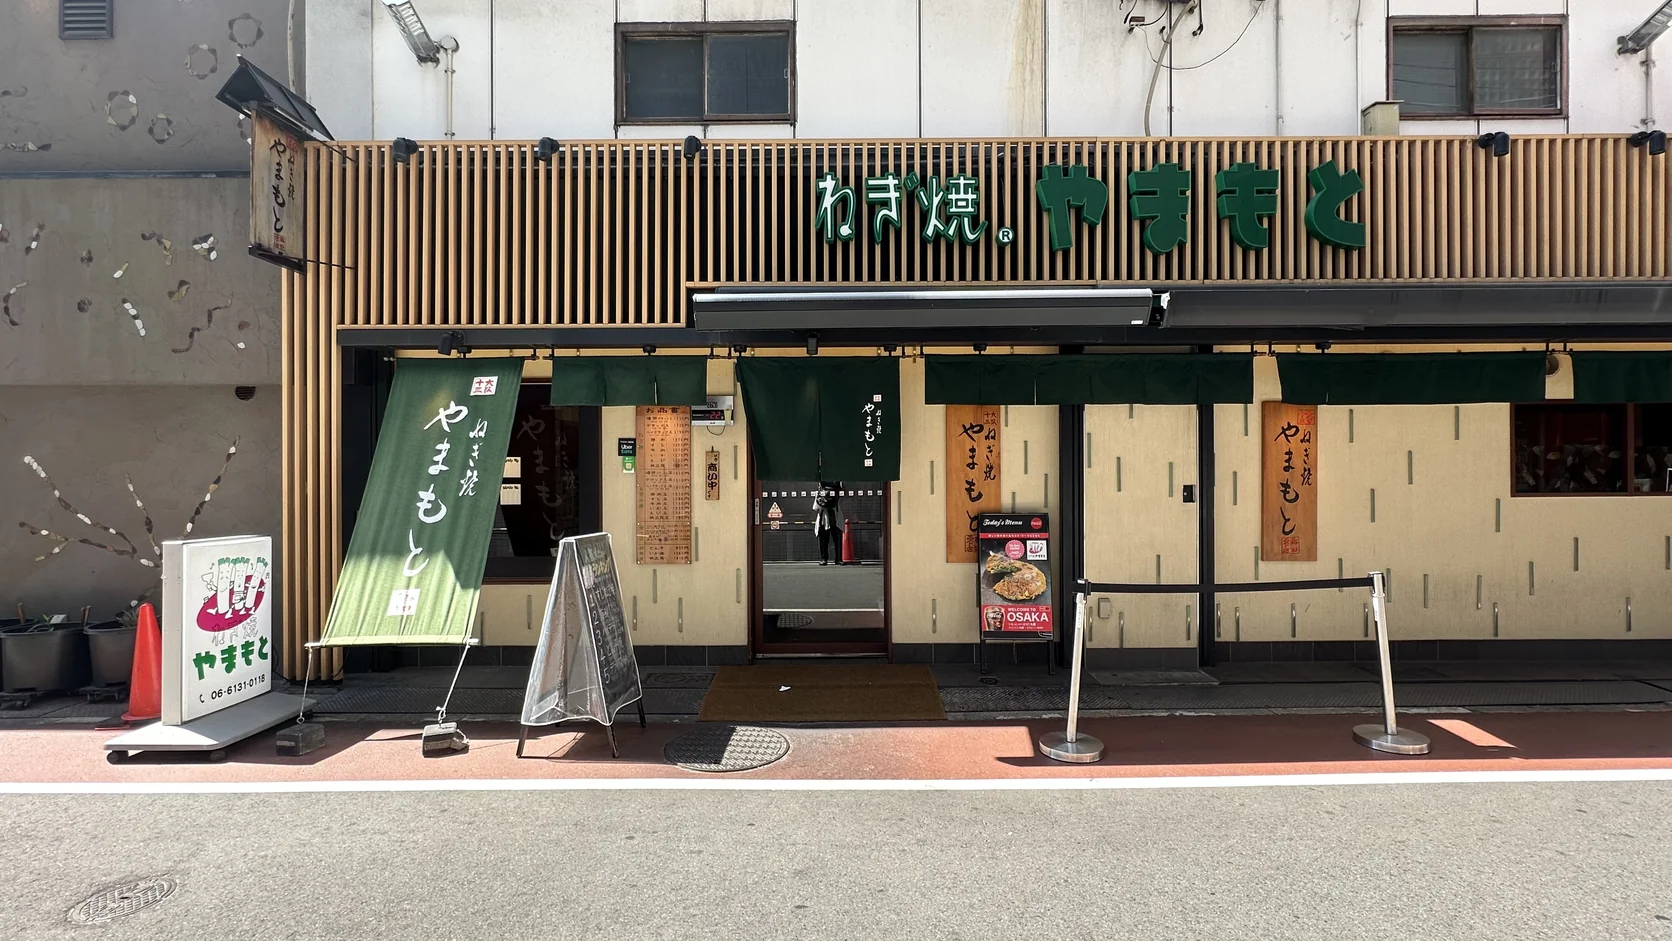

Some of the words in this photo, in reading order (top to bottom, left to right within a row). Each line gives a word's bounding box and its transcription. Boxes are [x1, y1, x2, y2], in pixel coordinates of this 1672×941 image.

[270, 137, 287, 233] やまもと
[814, 171, 988, 246] ねぎ焼
[1036, 159, 1366, 255] やまもと
[861, 402, 875, 457] やまもと
[984, 428, 997, 481] ねぎ焼
[458, 418, 488, 497] ねぎ焼
[517, 414, 565, 540] やまもと
[708, 462, 717, 490] 商い中
[958, 422, 984, 532] やまもと
[1274, 421, 1300, 536] やまもと
[1300, 429, 1313, 486] ねぎ焼
[402, 400, 470, 578] やまもと
[982, 518, 1004, 527] Today's
[592, 612, 599, 624] 2
[596, 631, 603, 646] 3
[1007, 612, 1049, 622] OSAKA
[192, 635, 269, 681] やまもと
[603, 668, 610, 684] 5
[211, 674, 266, 700] 06-6131-0118
